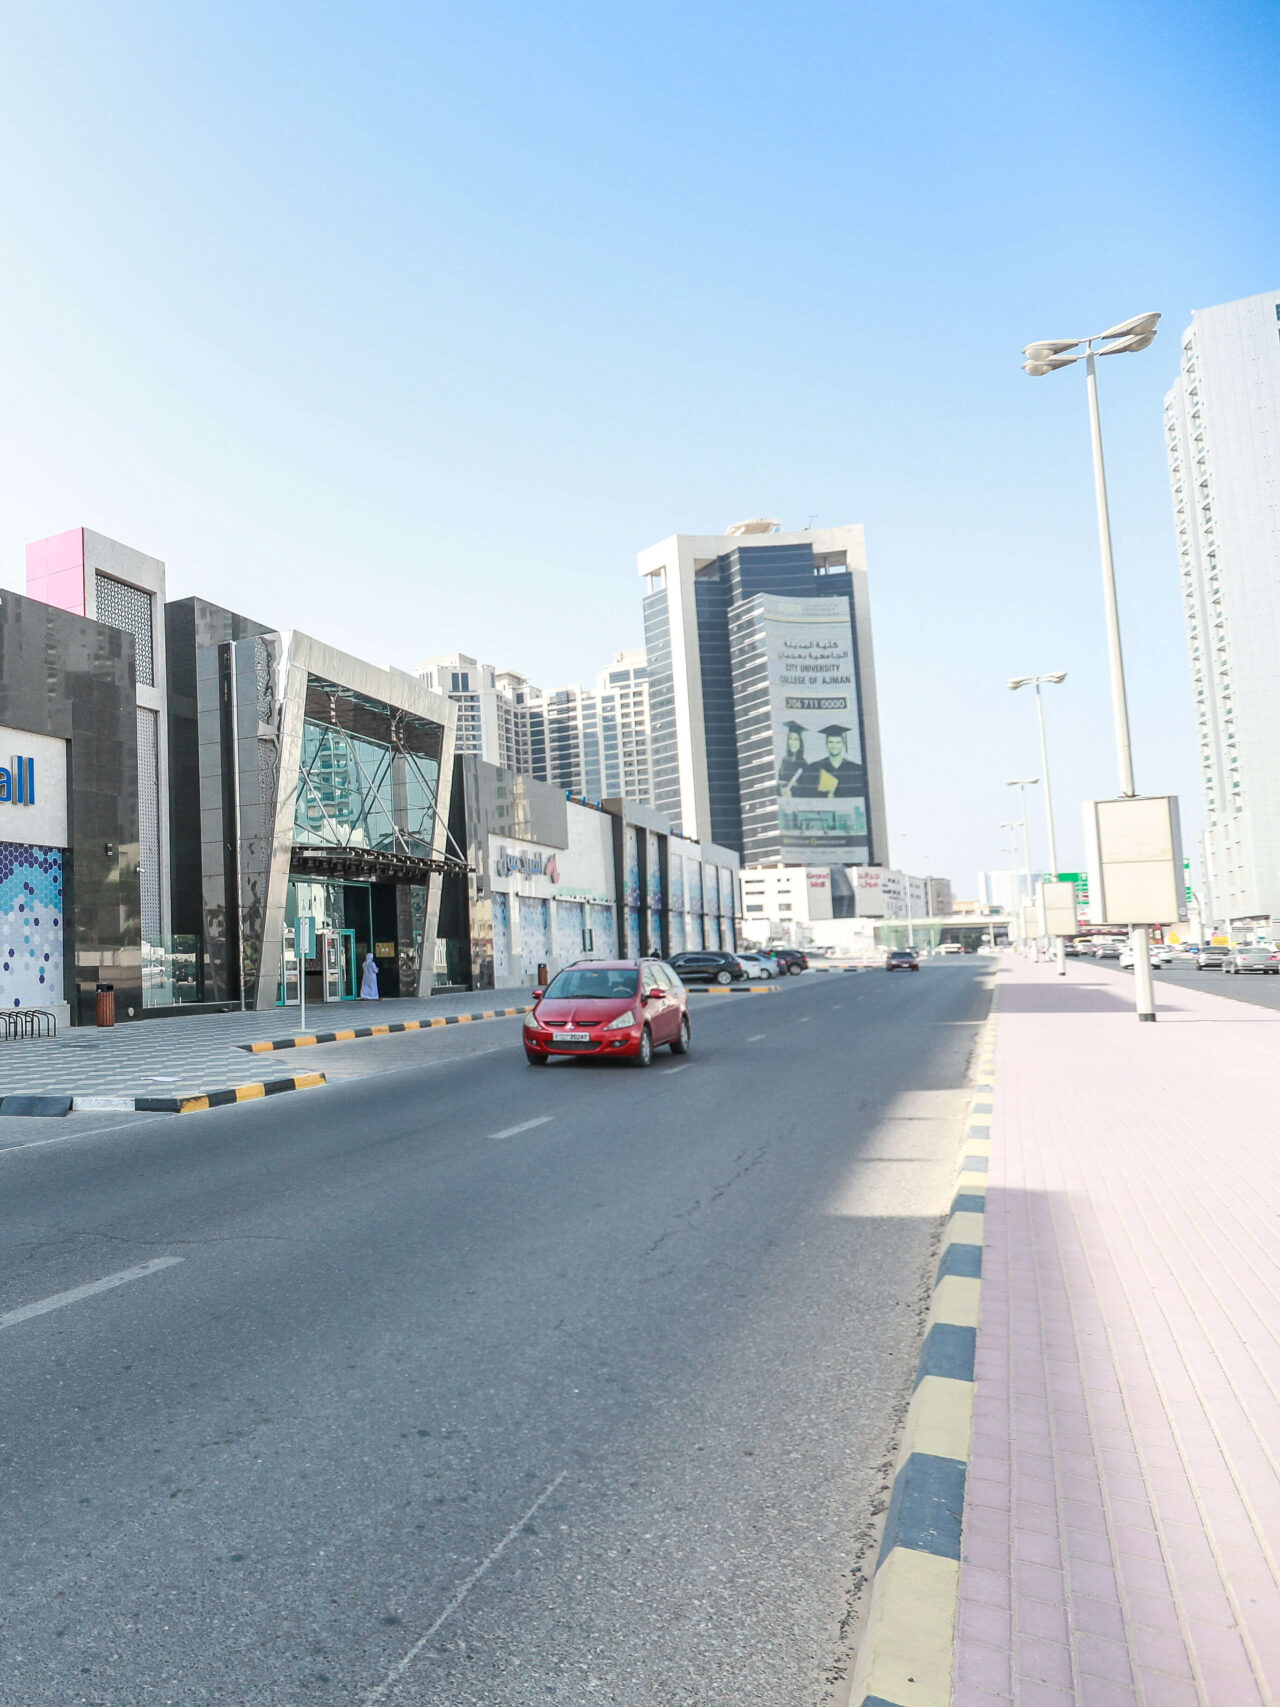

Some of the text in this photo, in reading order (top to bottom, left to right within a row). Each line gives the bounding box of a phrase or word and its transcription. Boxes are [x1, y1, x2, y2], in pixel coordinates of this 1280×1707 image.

[786, 664, 840, 673] CITY UNIVERSITY
[780, 676, 851, 684] COLLEGE OF AJMAN
[803, 699, 818, 708] 711
[821, 699, 845, 708] 0000
